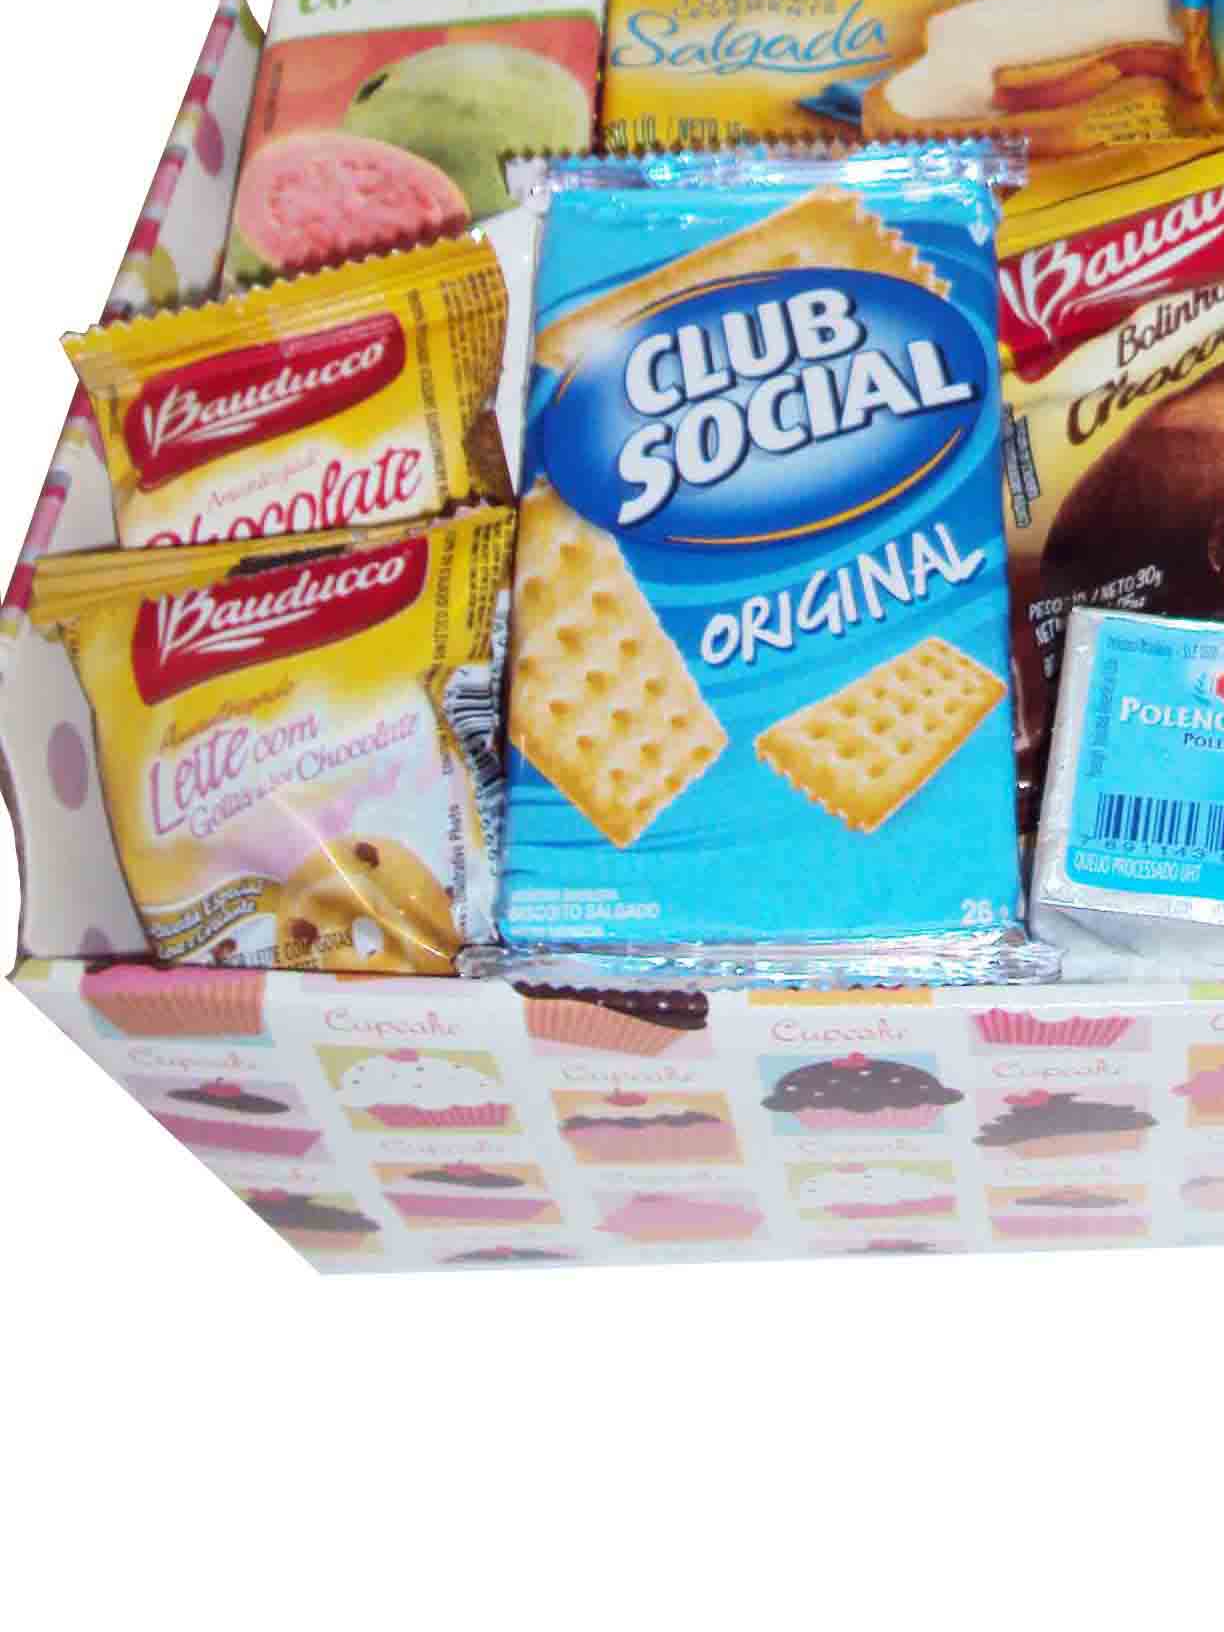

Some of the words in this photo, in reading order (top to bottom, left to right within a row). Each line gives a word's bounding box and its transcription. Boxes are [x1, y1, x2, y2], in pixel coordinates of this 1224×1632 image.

[611, 0, 892, 76] Salgada
[143, 342, 386, 457] Bauducco
[624, 287, 866, 417] CLUB
[617, 339, 975, 527] SOCIAL
[156, 554, 404, 667] Bauducco
[700, 522, 985, 667] ORIGINAL
[1028, 598, 1064, 622] PESO
[1101, 575, 1136, 600] NETO
[1135, 565, 1164, 589] 30g
[151, 725, 250, 836] Leite
[254, 713, 321, 763] com
[296, 711, 420, 782] Chocolate
